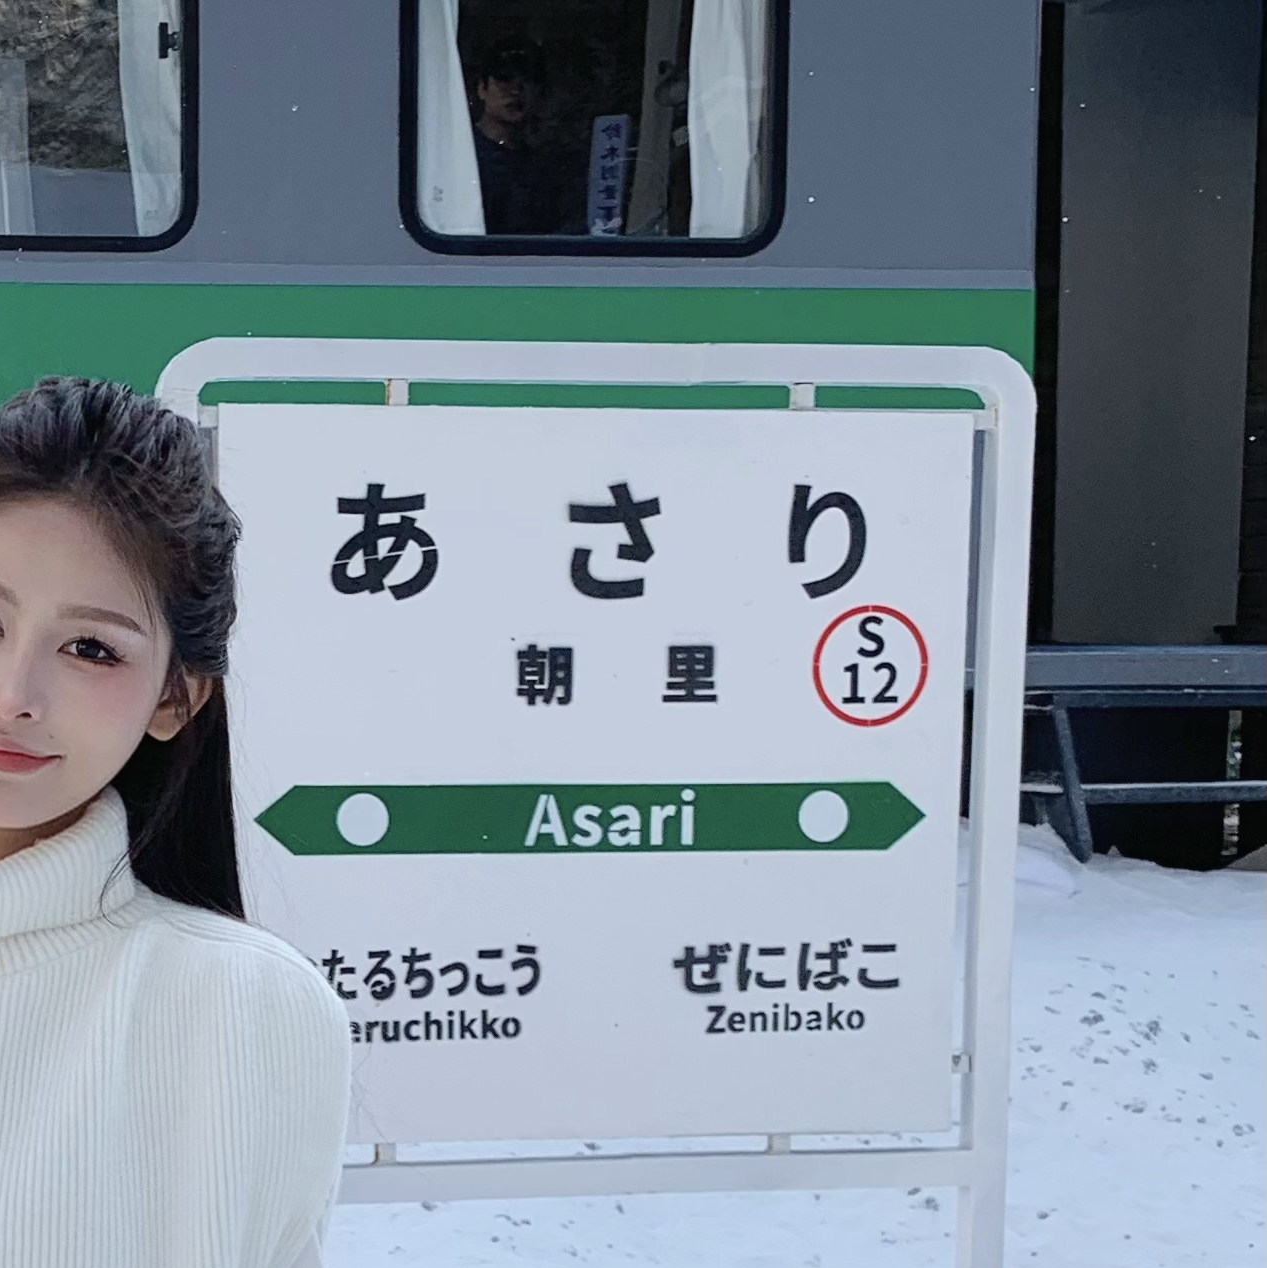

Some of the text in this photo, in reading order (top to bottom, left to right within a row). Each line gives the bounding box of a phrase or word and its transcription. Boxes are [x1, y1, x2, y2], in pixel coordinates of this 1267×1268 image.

[331, 483, 868, 601] あさり
[857, 616, 885, 658] S
[517, 644, 718, 706] 朝里
[842, 662, 899, 705] 12
[525, 789, 696, 848] Asari
[307, 944, 542, 1002] たるちっこう
[672, 938, 901, 995] ぜにばこ
[705, 1003, 867, 1034] Zenibako
